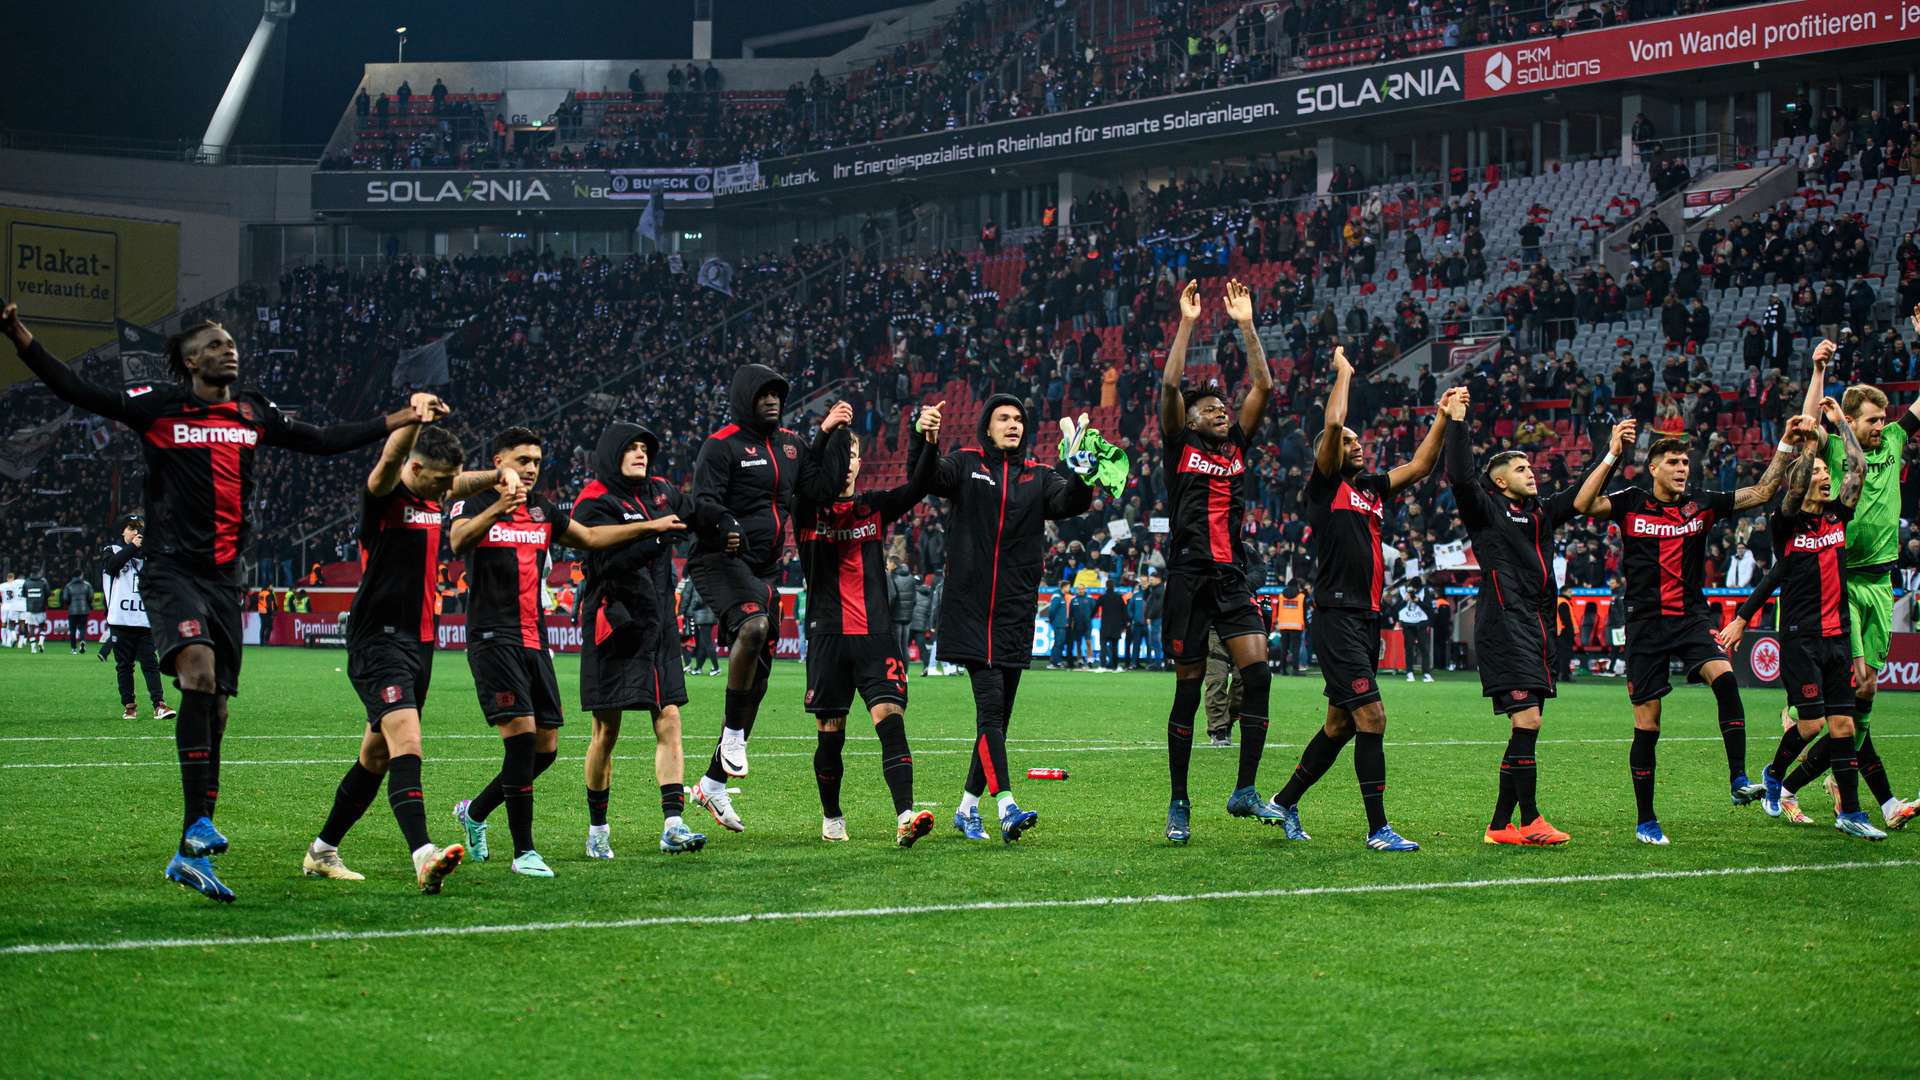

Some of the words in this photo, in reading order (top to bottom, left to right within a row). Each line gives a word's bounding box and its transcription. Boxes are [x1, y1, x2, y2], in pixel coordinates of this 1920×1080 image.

[1629, 40, 1673, 63] Vom
[1680, 23, 1757, 55] Wandel
[1764, 11, 1876, 49] profitieren
[1517, 46, 1550, 65] PKM
[1517, 58, 1601, 85] solutions
[1297, 65, 1461, 115] SOLARNIA
[512, 114, 528, 124] G5
[833, 162, 852, 180] Ihr
[977, 141, 994, 157] im
[997, 127, 1071, 155] Rheinland
[1102, 117, 1160, 140] smarte
[1163, 102, 1279, 131] Solaranlagen.
[367, 180, 551, 202] SOLARNIA
[772, 167, 820, 188] Autark.
[18, 244, 110, 277] Plakat-
[17, 279, 110, 300] verkauft.de
[1633, 517, 1704, 537] Barmenia
